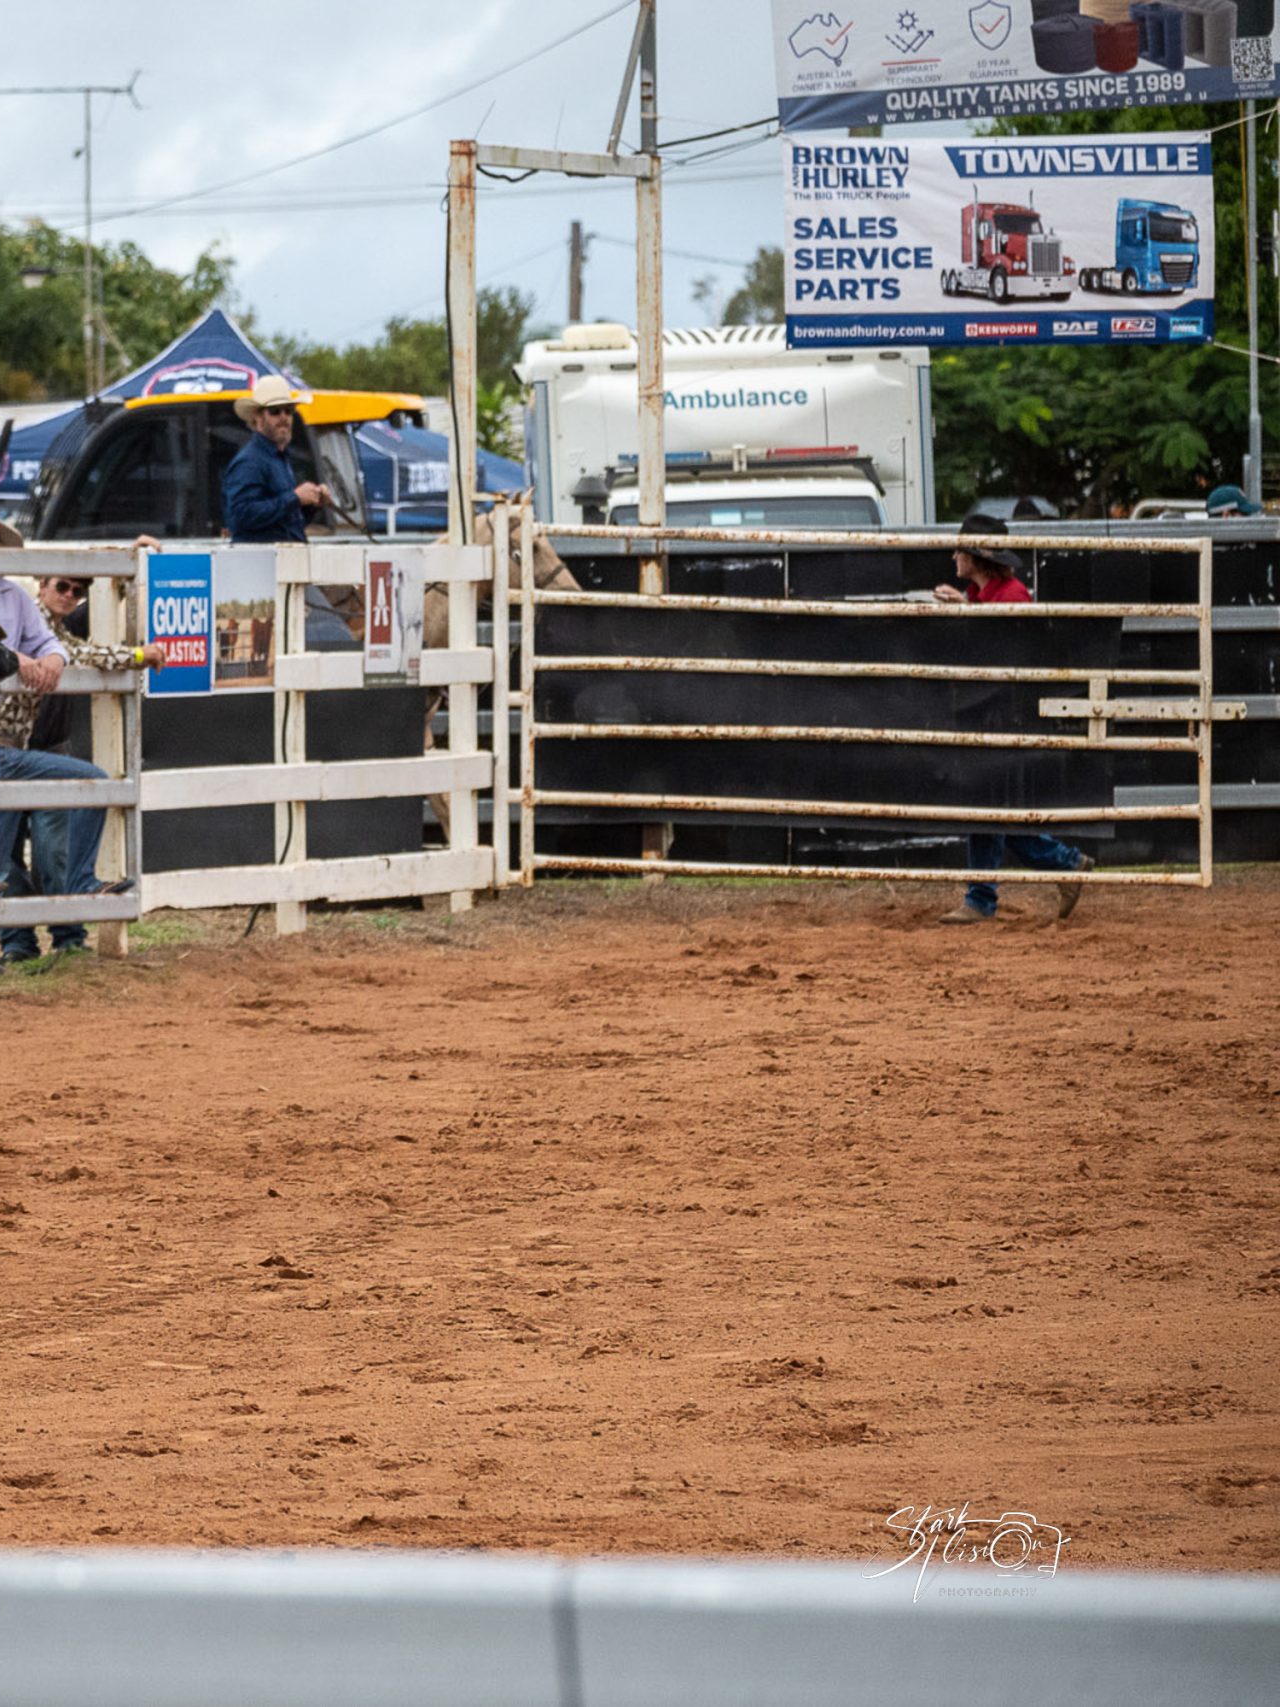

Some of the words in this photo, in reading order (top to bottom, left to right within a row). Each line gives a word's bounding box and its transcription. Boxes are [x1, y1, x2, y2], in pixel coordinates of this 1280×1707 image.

[886, 85, 980, 110] QUALITY
[985, 81, 1059, 104] TANKS
[1064, 76, 1129, 98] SINCE
[1134, 73, 1186, 93] 1989
[792, 147, 909, 165] BROWN
[959, 147, 1200, 174] TOWNSVILLE
[802, 167, 909, 189] HURLEY
[793, 191, 811, 200] The
[815, 191, 832, 200] BIG
[837, 191, 873, 200] TRUCK
[876, 191, 911, 201] People
[794, 217, 898, 239] SALES
[794, 247, 933, 270] SERVICE
[795, 278, 901, 301] PARTS
[794, 325, 945, 339] brownandhurley.com.au
[978, 324, 1037, 335] KENWORTH
[1053, 321, 1098, 335] DAF
[662, 388, 808, 409] Ambulance
[153, 596, 208, 635] GOUGH
